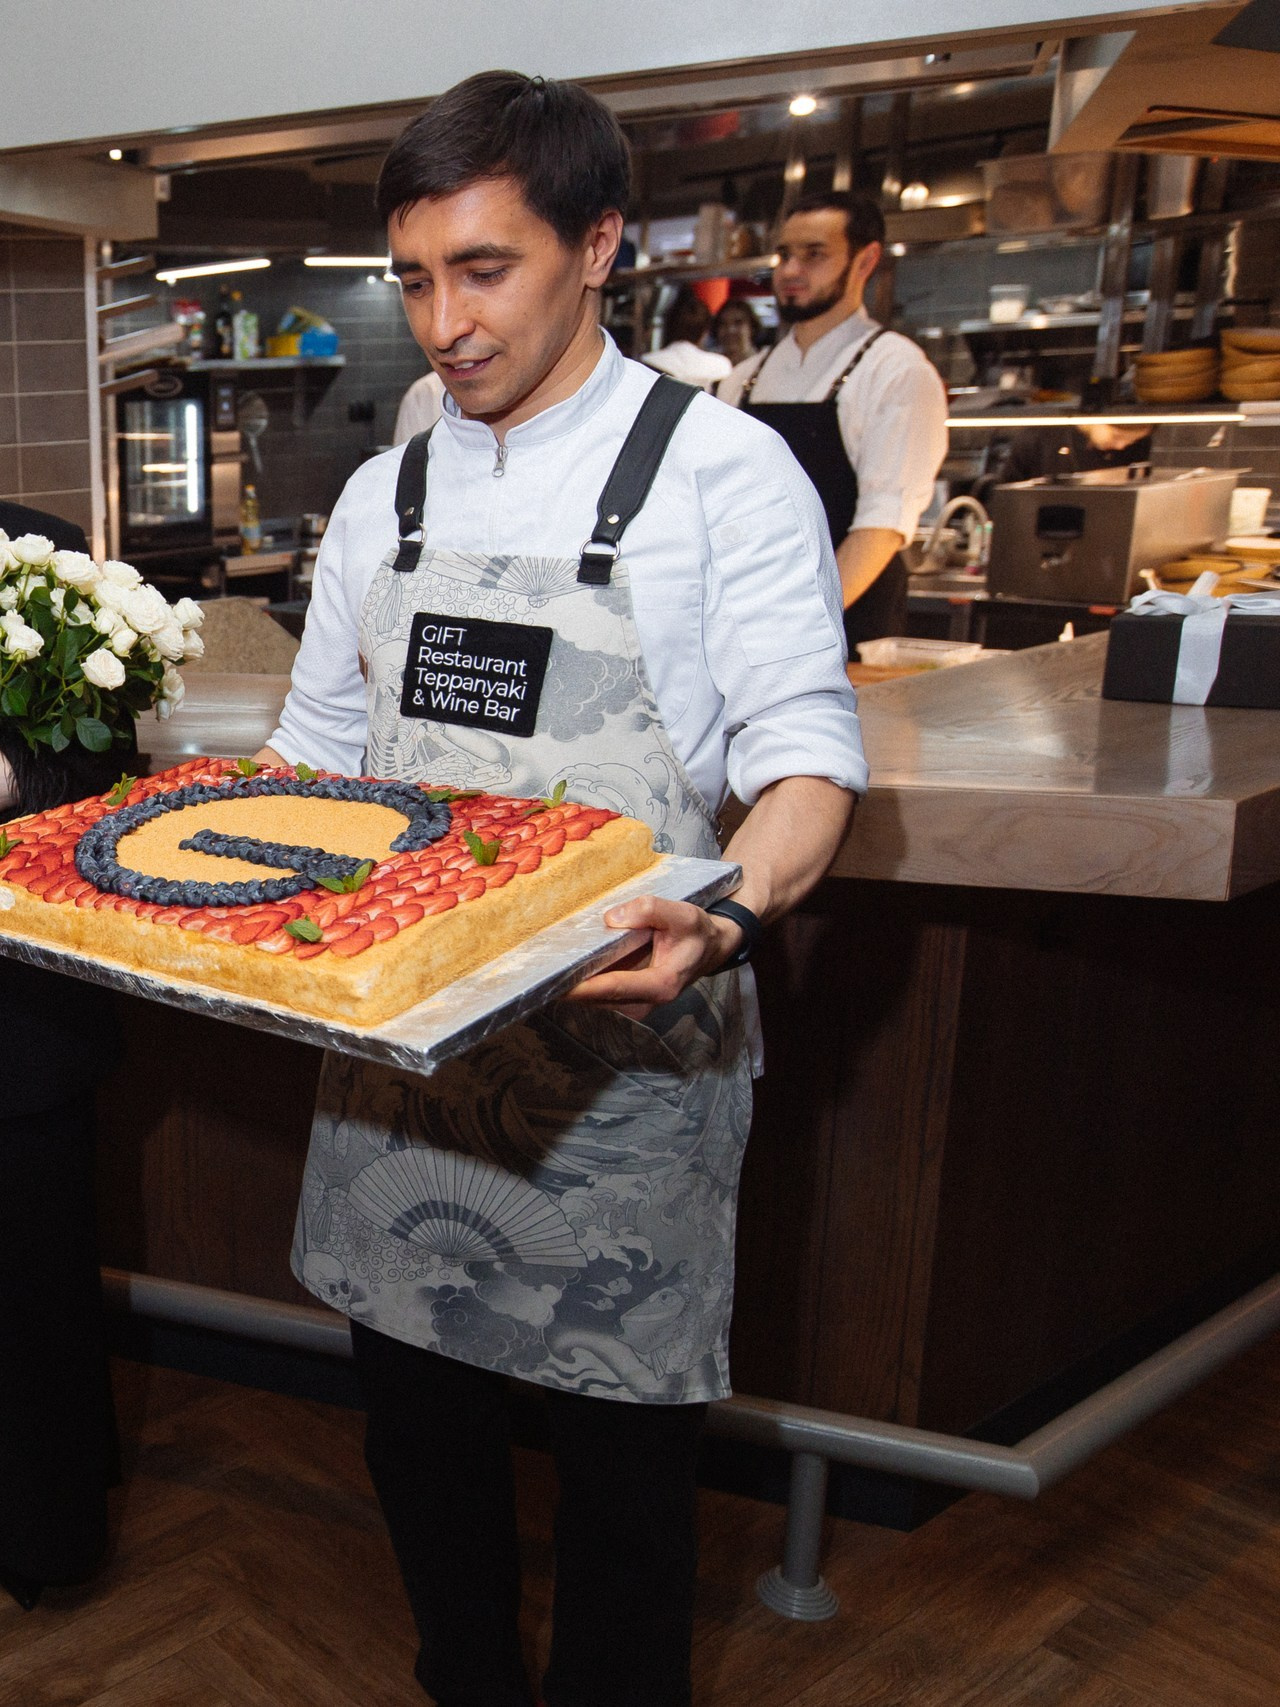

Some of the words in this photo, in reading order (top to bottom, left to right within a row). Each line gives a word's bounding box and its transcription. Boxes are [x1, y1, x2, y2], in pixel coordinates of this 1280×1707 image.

[422, 625, 467, 646] GIFT
[418, 646, 527, 677] Restaurant
[415, 667, 528, 700] Teppanyaki
[413, 689, 425, 706] &
[430, 690, 480, 713] Wine
[484, 699, 520, 722] Bar
